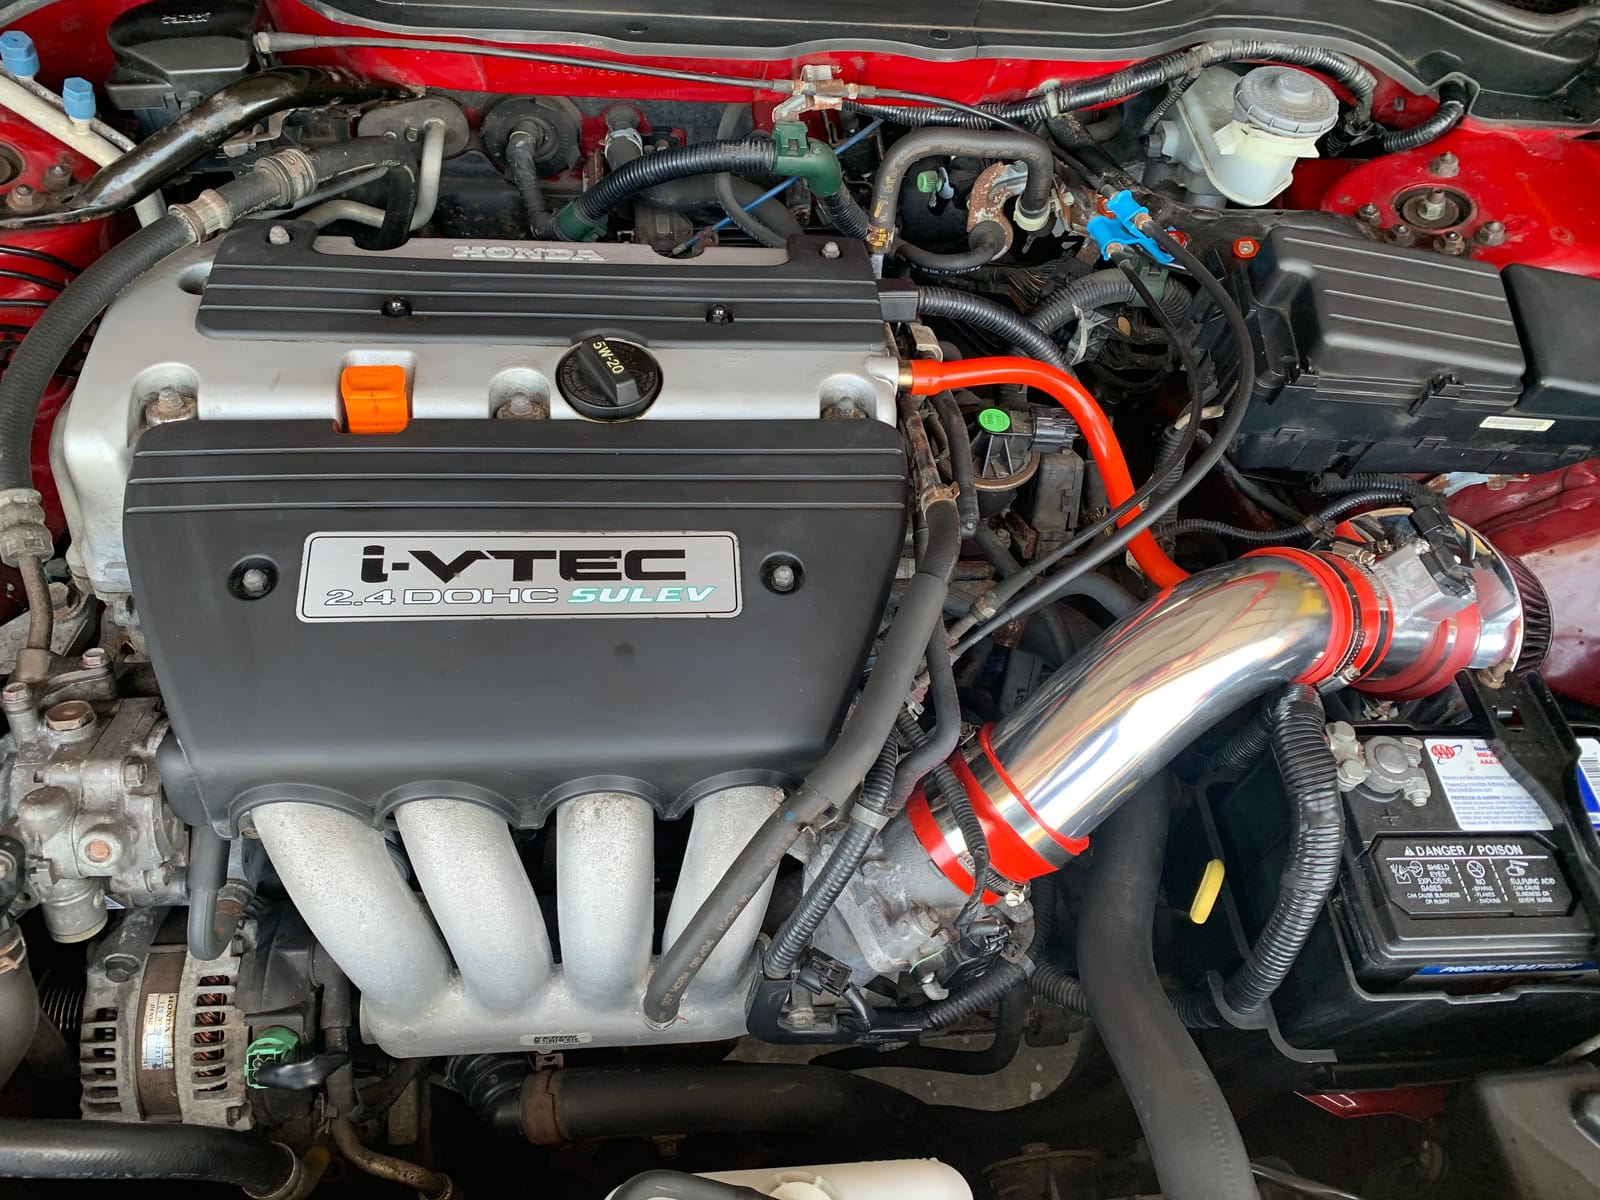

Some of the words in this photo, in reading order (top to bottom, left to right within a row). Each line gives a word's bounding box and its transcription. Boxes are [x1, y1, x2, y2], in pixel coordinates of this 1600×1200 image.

[452, 245, 606, 261] HONDA
[592, 341, 625, 374] 5W-20
[360, 545, 686, 584] i-VTEC
[324, 588, 396, 606] 2.4
[403, 587, 559, 605] DOHC
[566, 586, 717, 604] SULEV
[1416, 846, 1466, 856] DANGER
[1477, 845, 1524, 855] POISON
[1418, 877, 1453, 885] EXPLOSIVE
[165, 995, 174, 1033] HONDA
